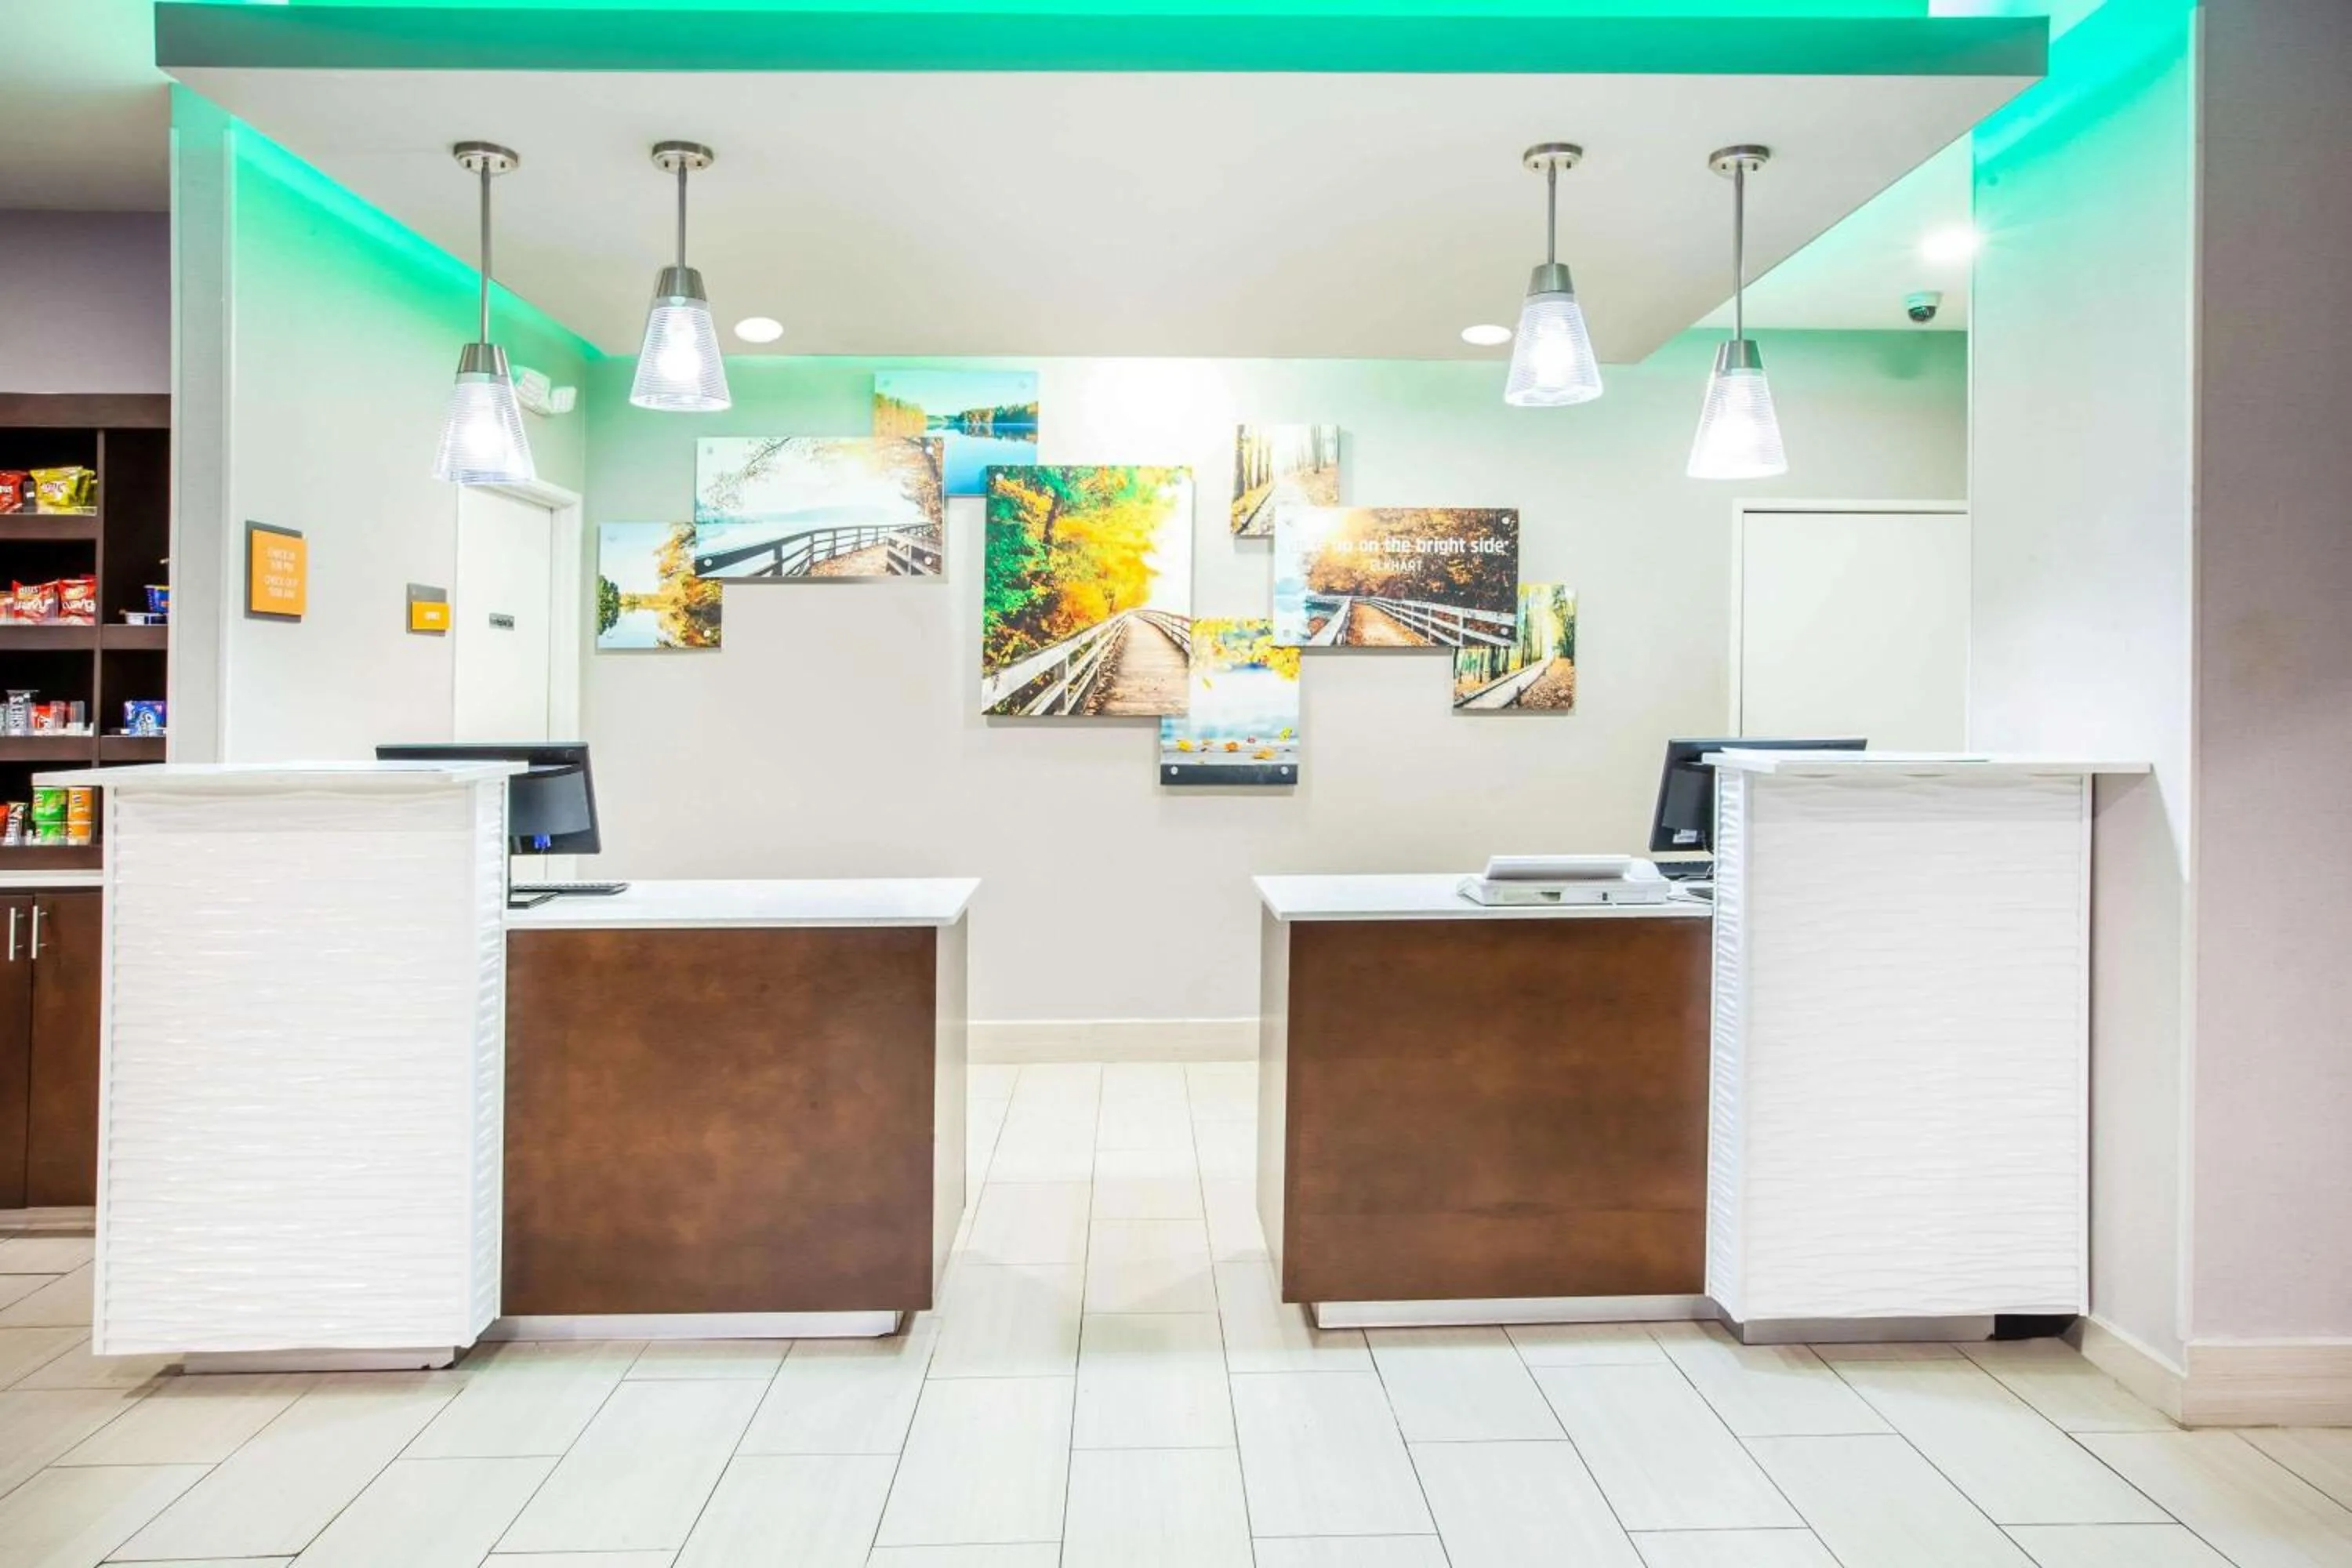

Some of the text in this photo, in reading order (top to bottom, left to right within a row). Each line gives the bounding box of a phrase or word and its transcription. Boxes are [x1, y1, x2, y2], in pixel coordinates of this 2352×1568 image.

[1336, 539, 1352, 555] up
[1359, 540, 1378, 553] on
[1385, 538, 1410, 553] the
[1414, 538, 1466, 556] bright
[1370, 560, 1422, 572] ELKHART
